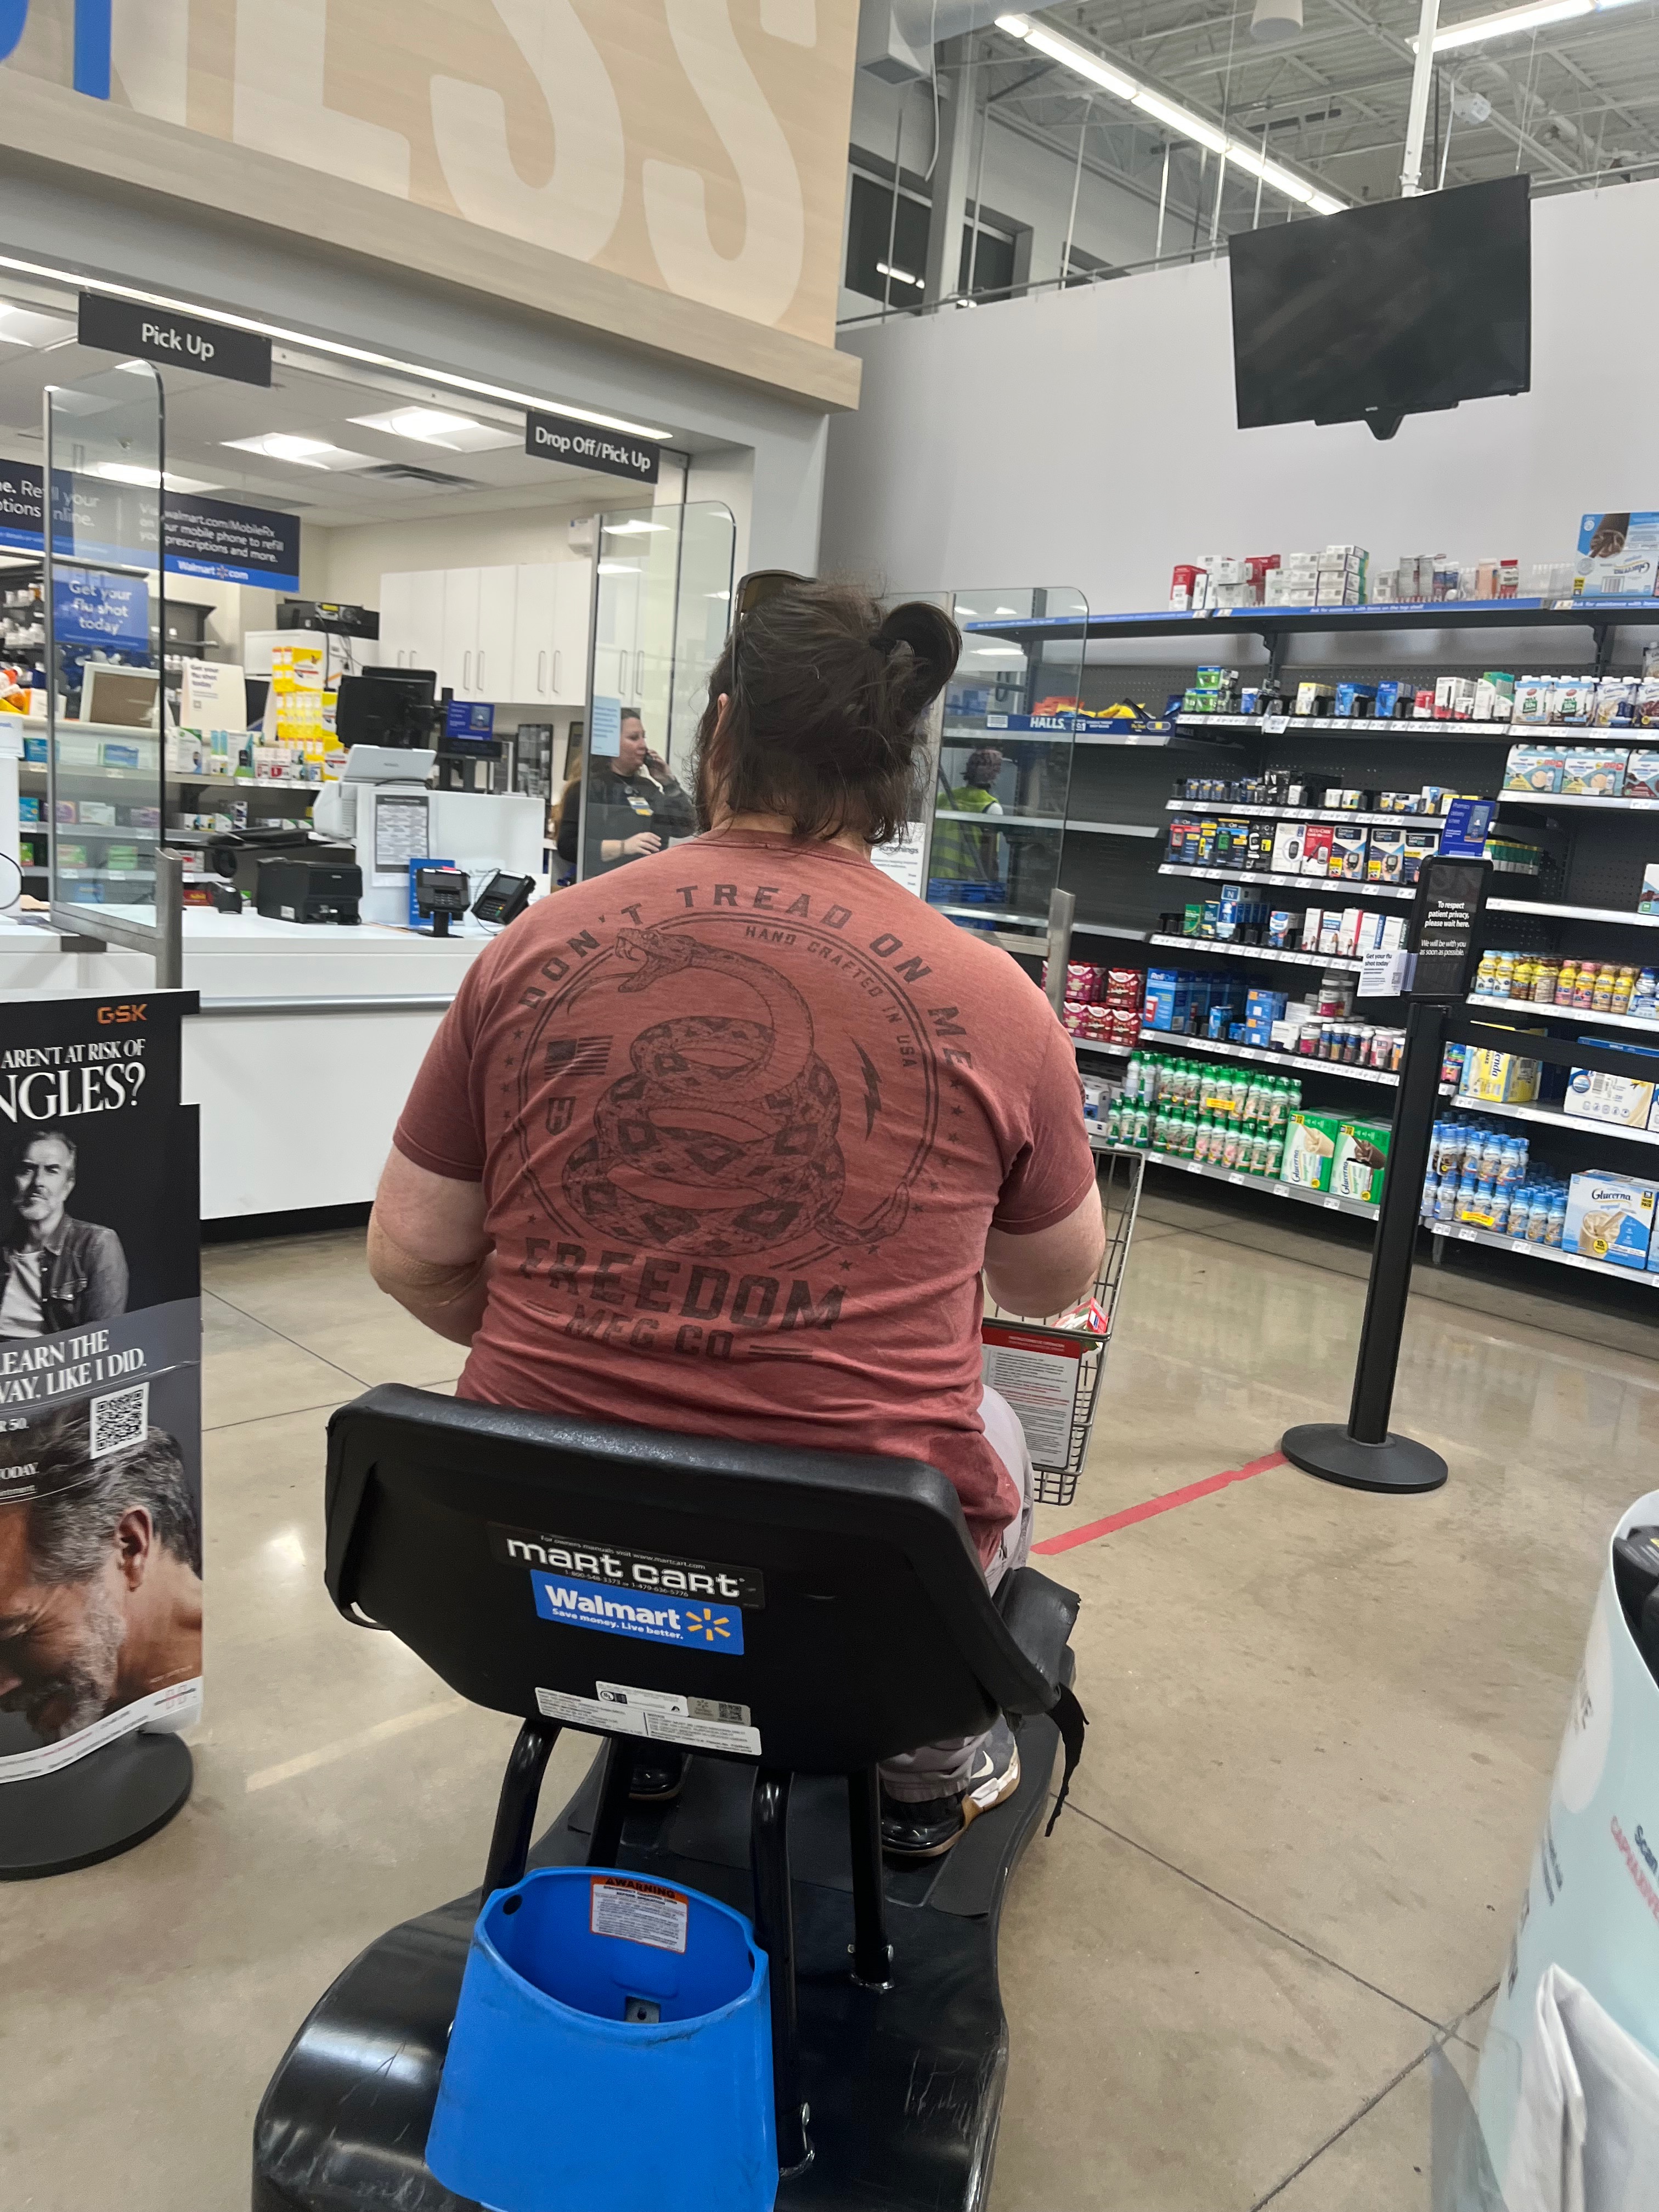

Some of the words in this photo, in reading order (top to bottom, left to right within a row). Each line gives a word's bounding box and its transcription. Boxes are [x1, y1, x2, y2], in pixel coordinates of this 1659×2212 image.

[142, 323, 182, 351] Pick
[187, 332, 215, 361] Up
[535, 426, 571, 454] Drop
[573, 437, 629, 465] Off/Pick
[631, 450, 651, 472] Up
[63, 492, 100, 508] your
[53, 507, 96, 527] nline.
[69, 580, 98, 597] Get
[99, 588, 133, 603] your
[97, 602, 129, 618] shot
[1030, 717, 1065, 730] HALLS
[1428, 910, 1448, 919] patient
[1448, 910, 1470, 920] privacy,
[1438, 900, 1444, 909] To
[1424, 918, 1443, 928] please
[1455, 919, 1470, 928] here.
[1421, 939, 1430, 947] We
[518, 902, 642, 1009] DON'T
[676, 884, 853, 929] TREAD
[869, 933, 933, 983] ON
[928, 1006, 974, 1070] ME
[744, 926, 797, 946] HAND
[807, 940, 884, 998] CRAFTED
[882, 1005, 902, 1024] IN
[896, 1034, 918, 1069] USA
[97, 1003, 148, 1024] GSK
[64, 1045, 86, 1064] AT
[88, 1041, 122, 1061] RISK
[123, 1039, 146, 1057] OF
[1291, 1149, 1300, 1182] Glucerna
[1341, 1161, 1350, 1195] Glucerna
[1592, 1188, 1632, 1201] Glucerna
[518, 1237, 848, 1332] FREEDOM
[69, 1329, 110, 1360] THE
[565, 1304, 660, 1352] MFG
[674, 1324, 735, 1361] CO
[46, 1362, 92, 1395] LIKE
[95, 1359, 104, 1381] I
[108, 1348, 147, 1378] DID.
[506, 1538, 624, 1578] mart
[631, 1562, 740, 1598] cart
[545, 1584, 681, 1630] Walmart
[552, 1608, 578, 1620] Save
[580, 1615, 620, 1628] money.
[621, 1622, 645, 1633] Live
[646, 1626, 684, 1640] better.
